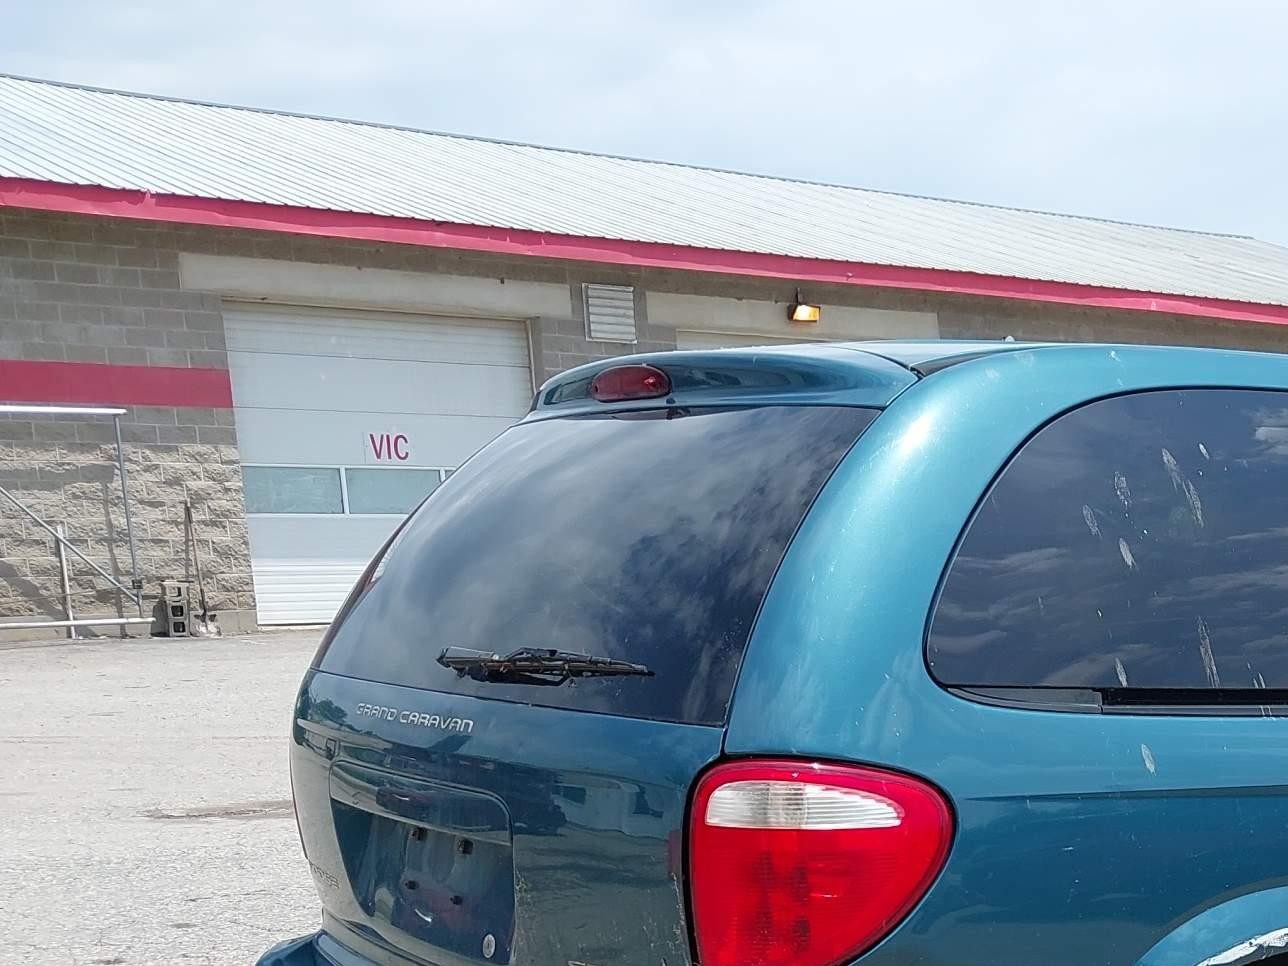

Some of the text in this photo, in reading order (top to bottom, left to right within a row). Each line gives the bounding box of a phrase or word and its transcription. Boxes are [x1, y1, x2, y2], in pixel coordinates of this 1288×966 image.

[369, 433, 409, 461] VIC
[356, 702, 474, 733] GRAND CARAVAN
